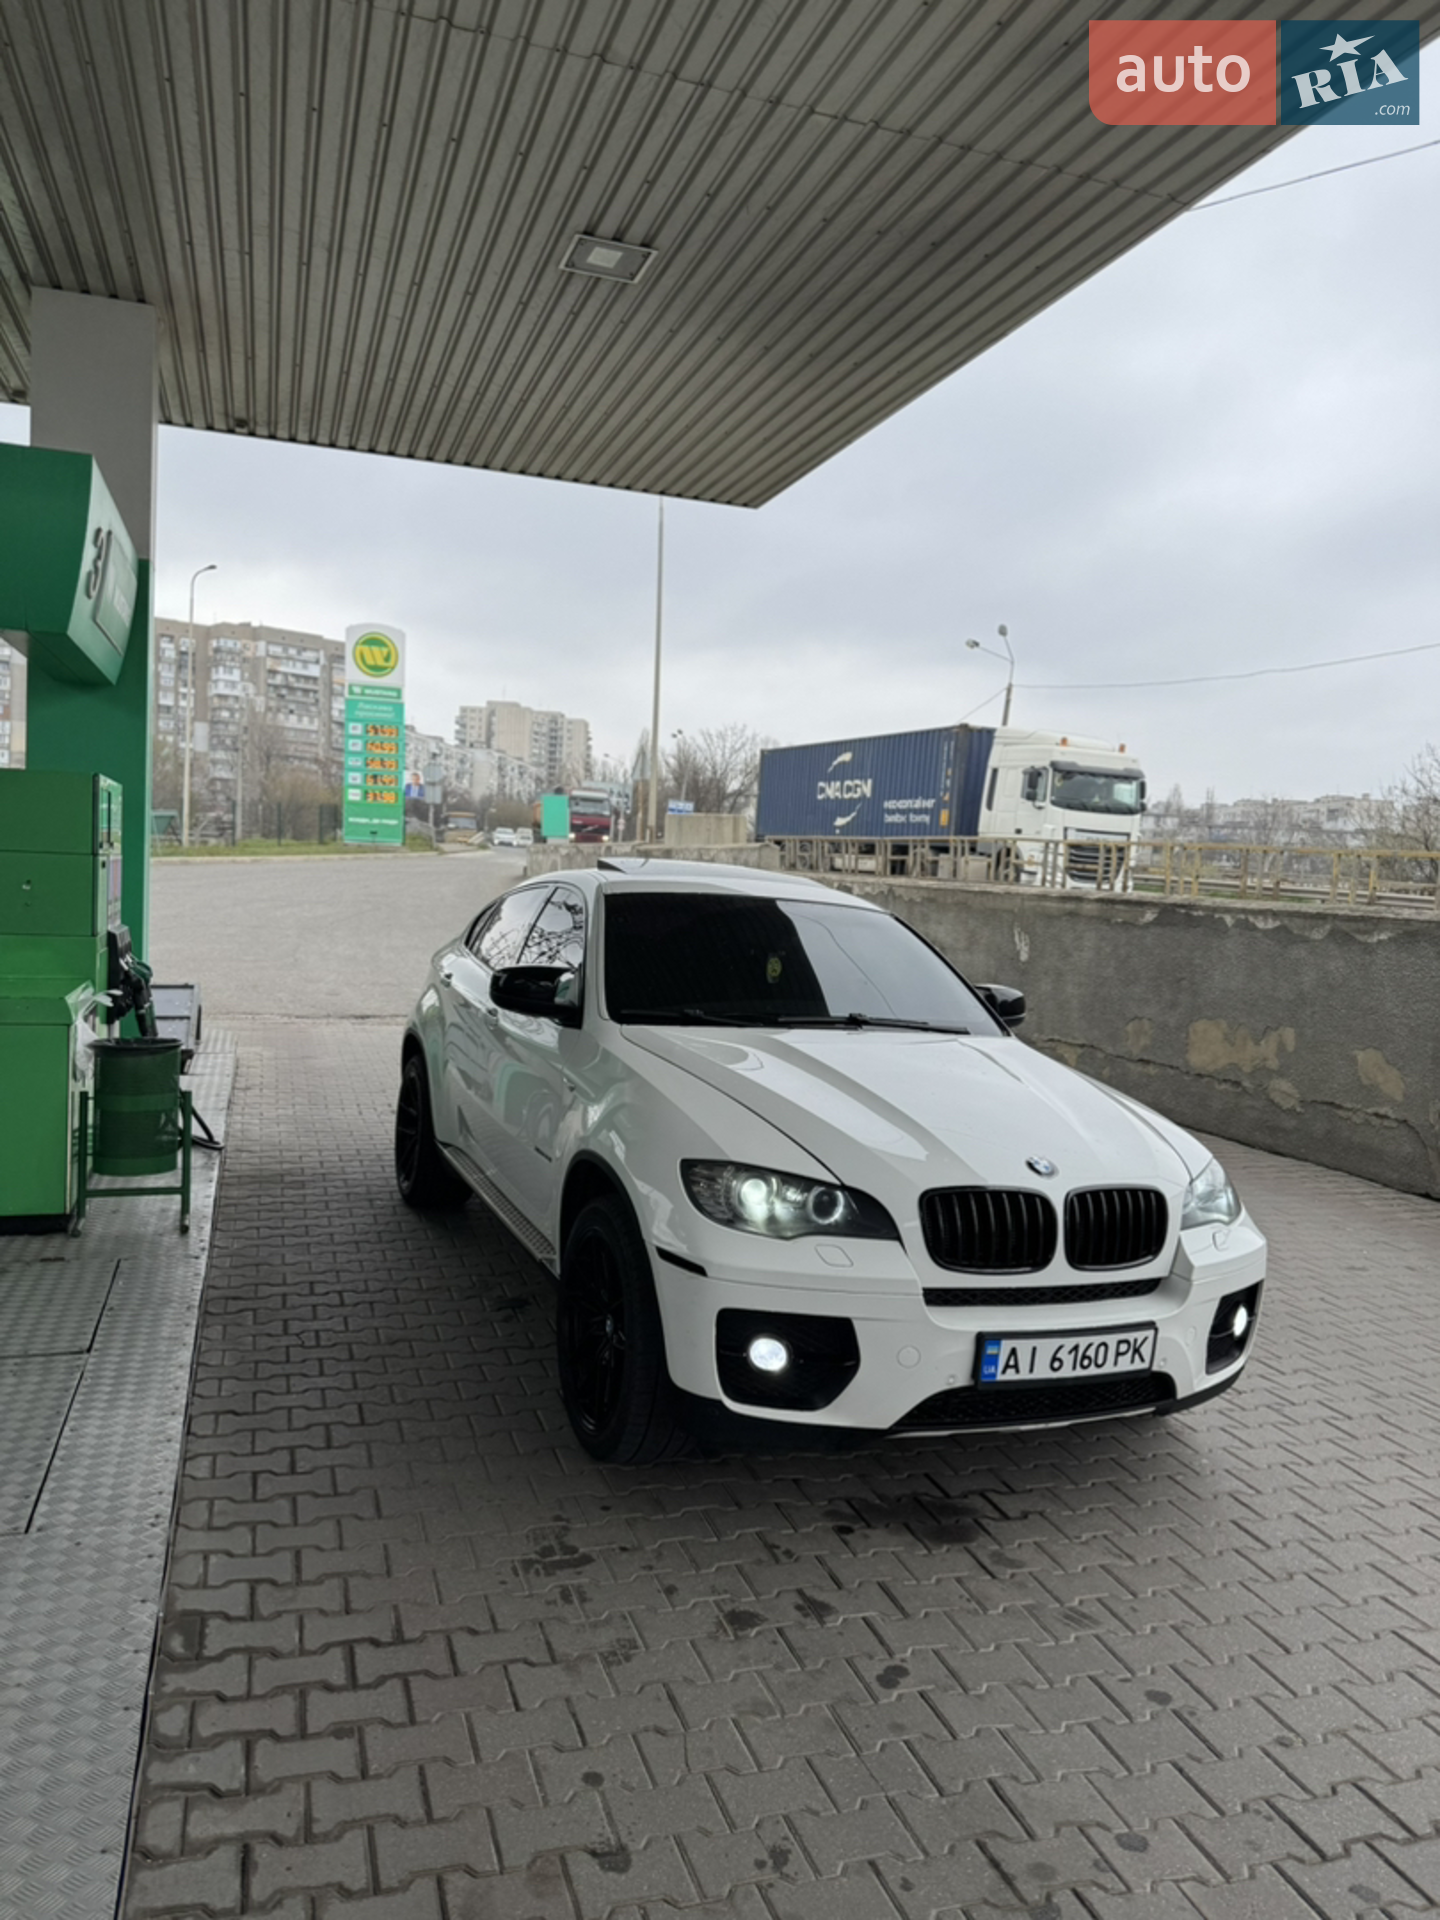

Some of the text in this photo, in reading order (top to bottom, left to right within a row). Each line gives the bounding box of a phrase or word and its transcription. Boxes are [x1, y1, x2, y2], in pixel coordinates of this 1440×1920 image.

[1001, 1336, 1149, 1375] AI 6160 PK
